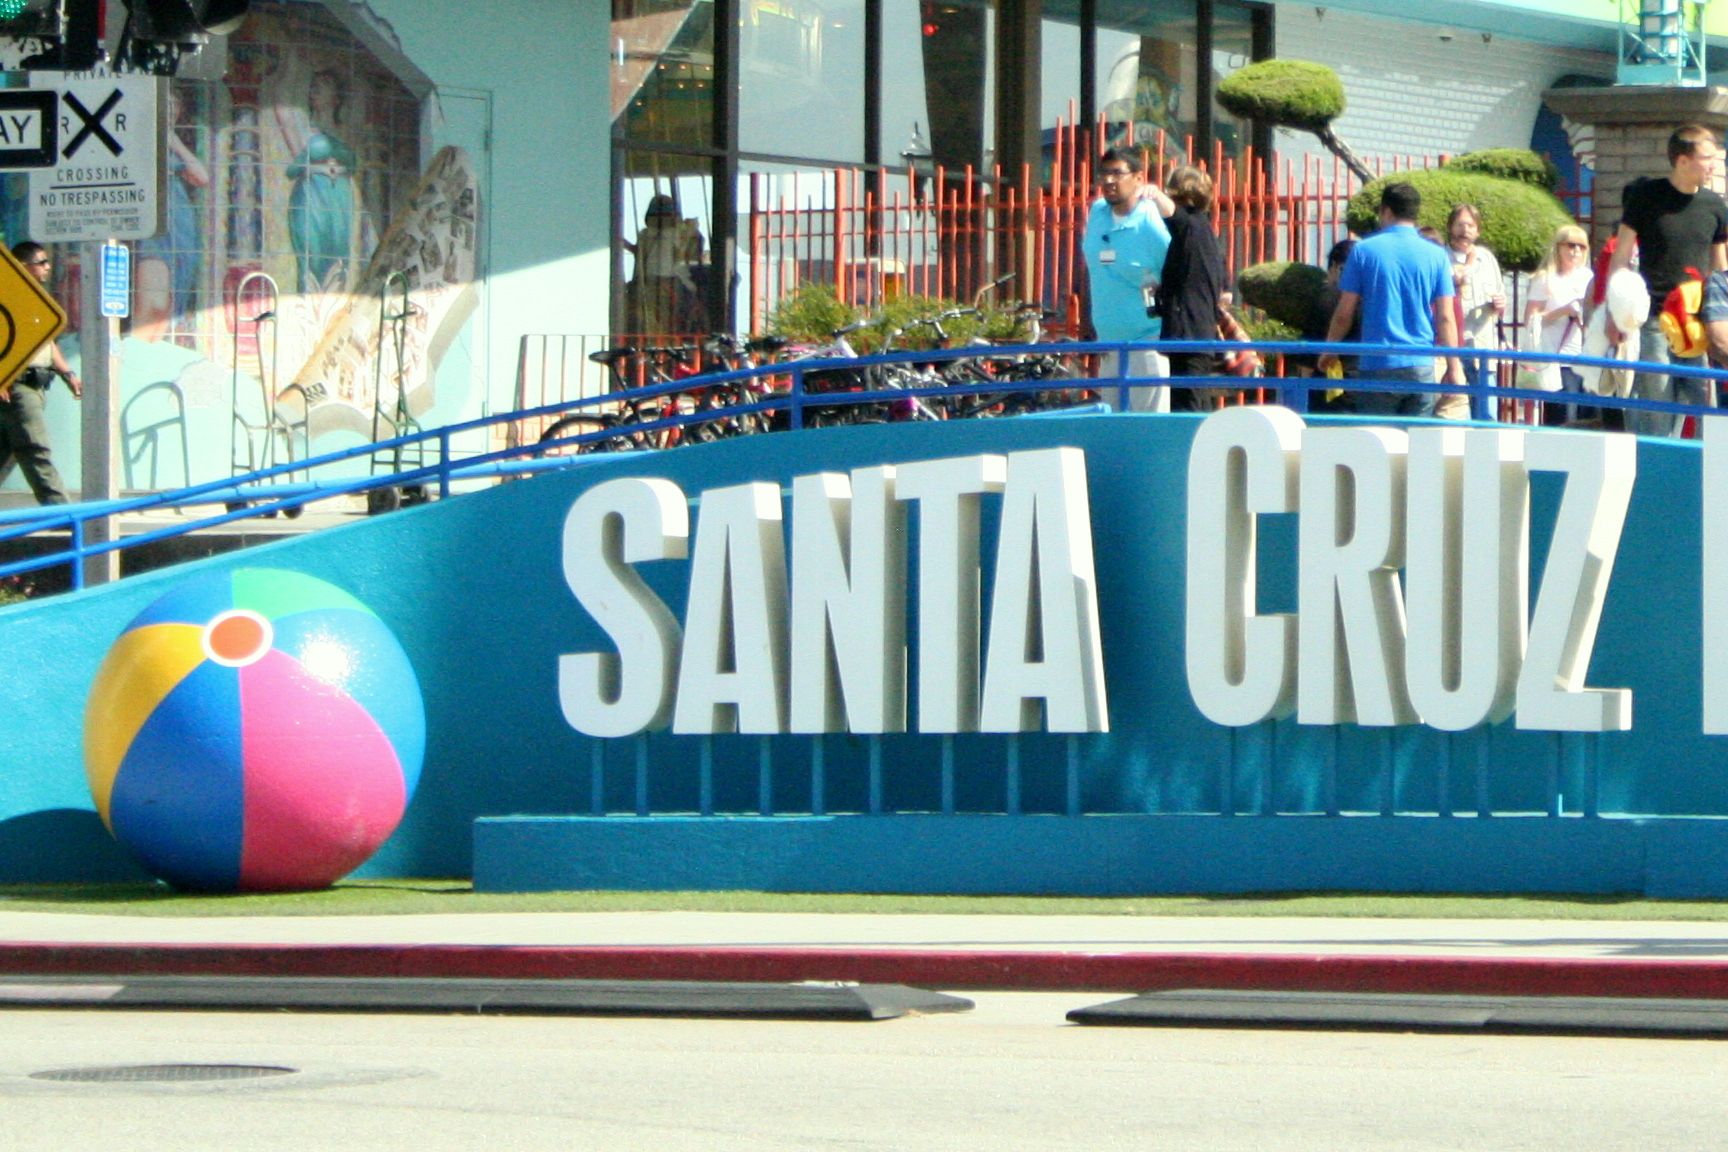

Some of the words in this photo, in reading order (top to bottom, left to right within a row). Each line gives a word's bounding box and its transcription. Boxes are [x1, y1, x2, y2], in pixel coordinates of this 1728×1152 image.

[57, 166, 129, 182] CROSSING
[40, 193, 57, 207] NO
[62, 189, 146, 207] TRESPASSING
[557, 446, 1109, 738] SANTA
[1185, 404, 1637, 732] CRUZ
